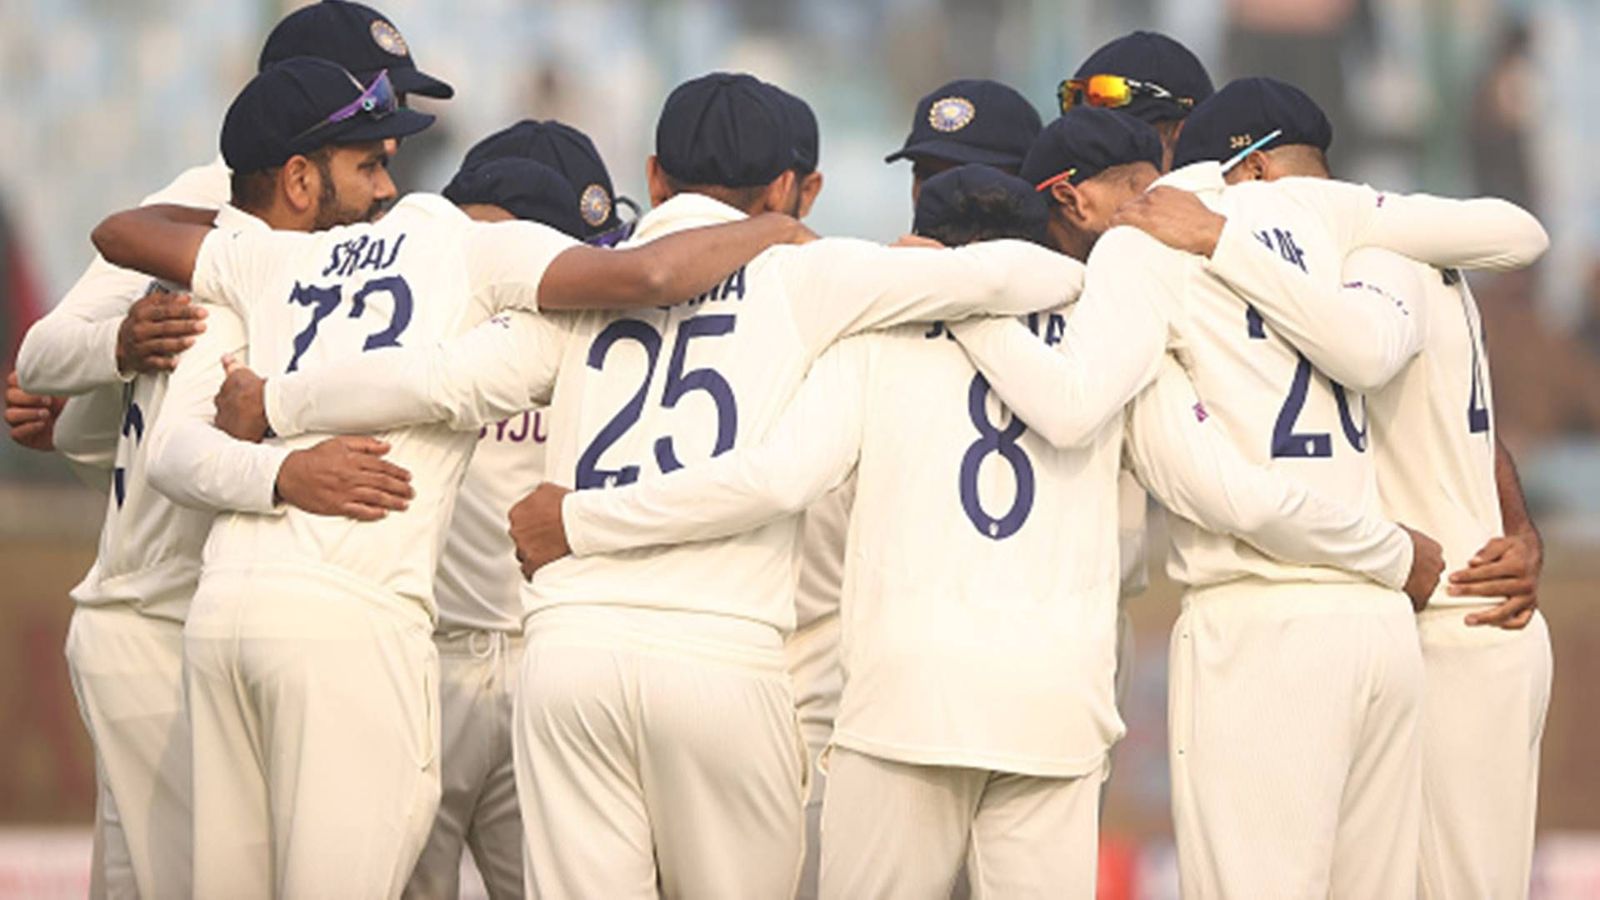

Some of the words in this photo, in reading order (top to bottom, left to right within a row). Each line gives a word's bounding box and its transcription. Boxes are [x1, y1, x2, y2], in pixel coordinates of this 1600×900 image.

[478, 410, 547, 443] YJU
[575, 313, 738, 491] 25
[959, 369, 1036, 541] 8
